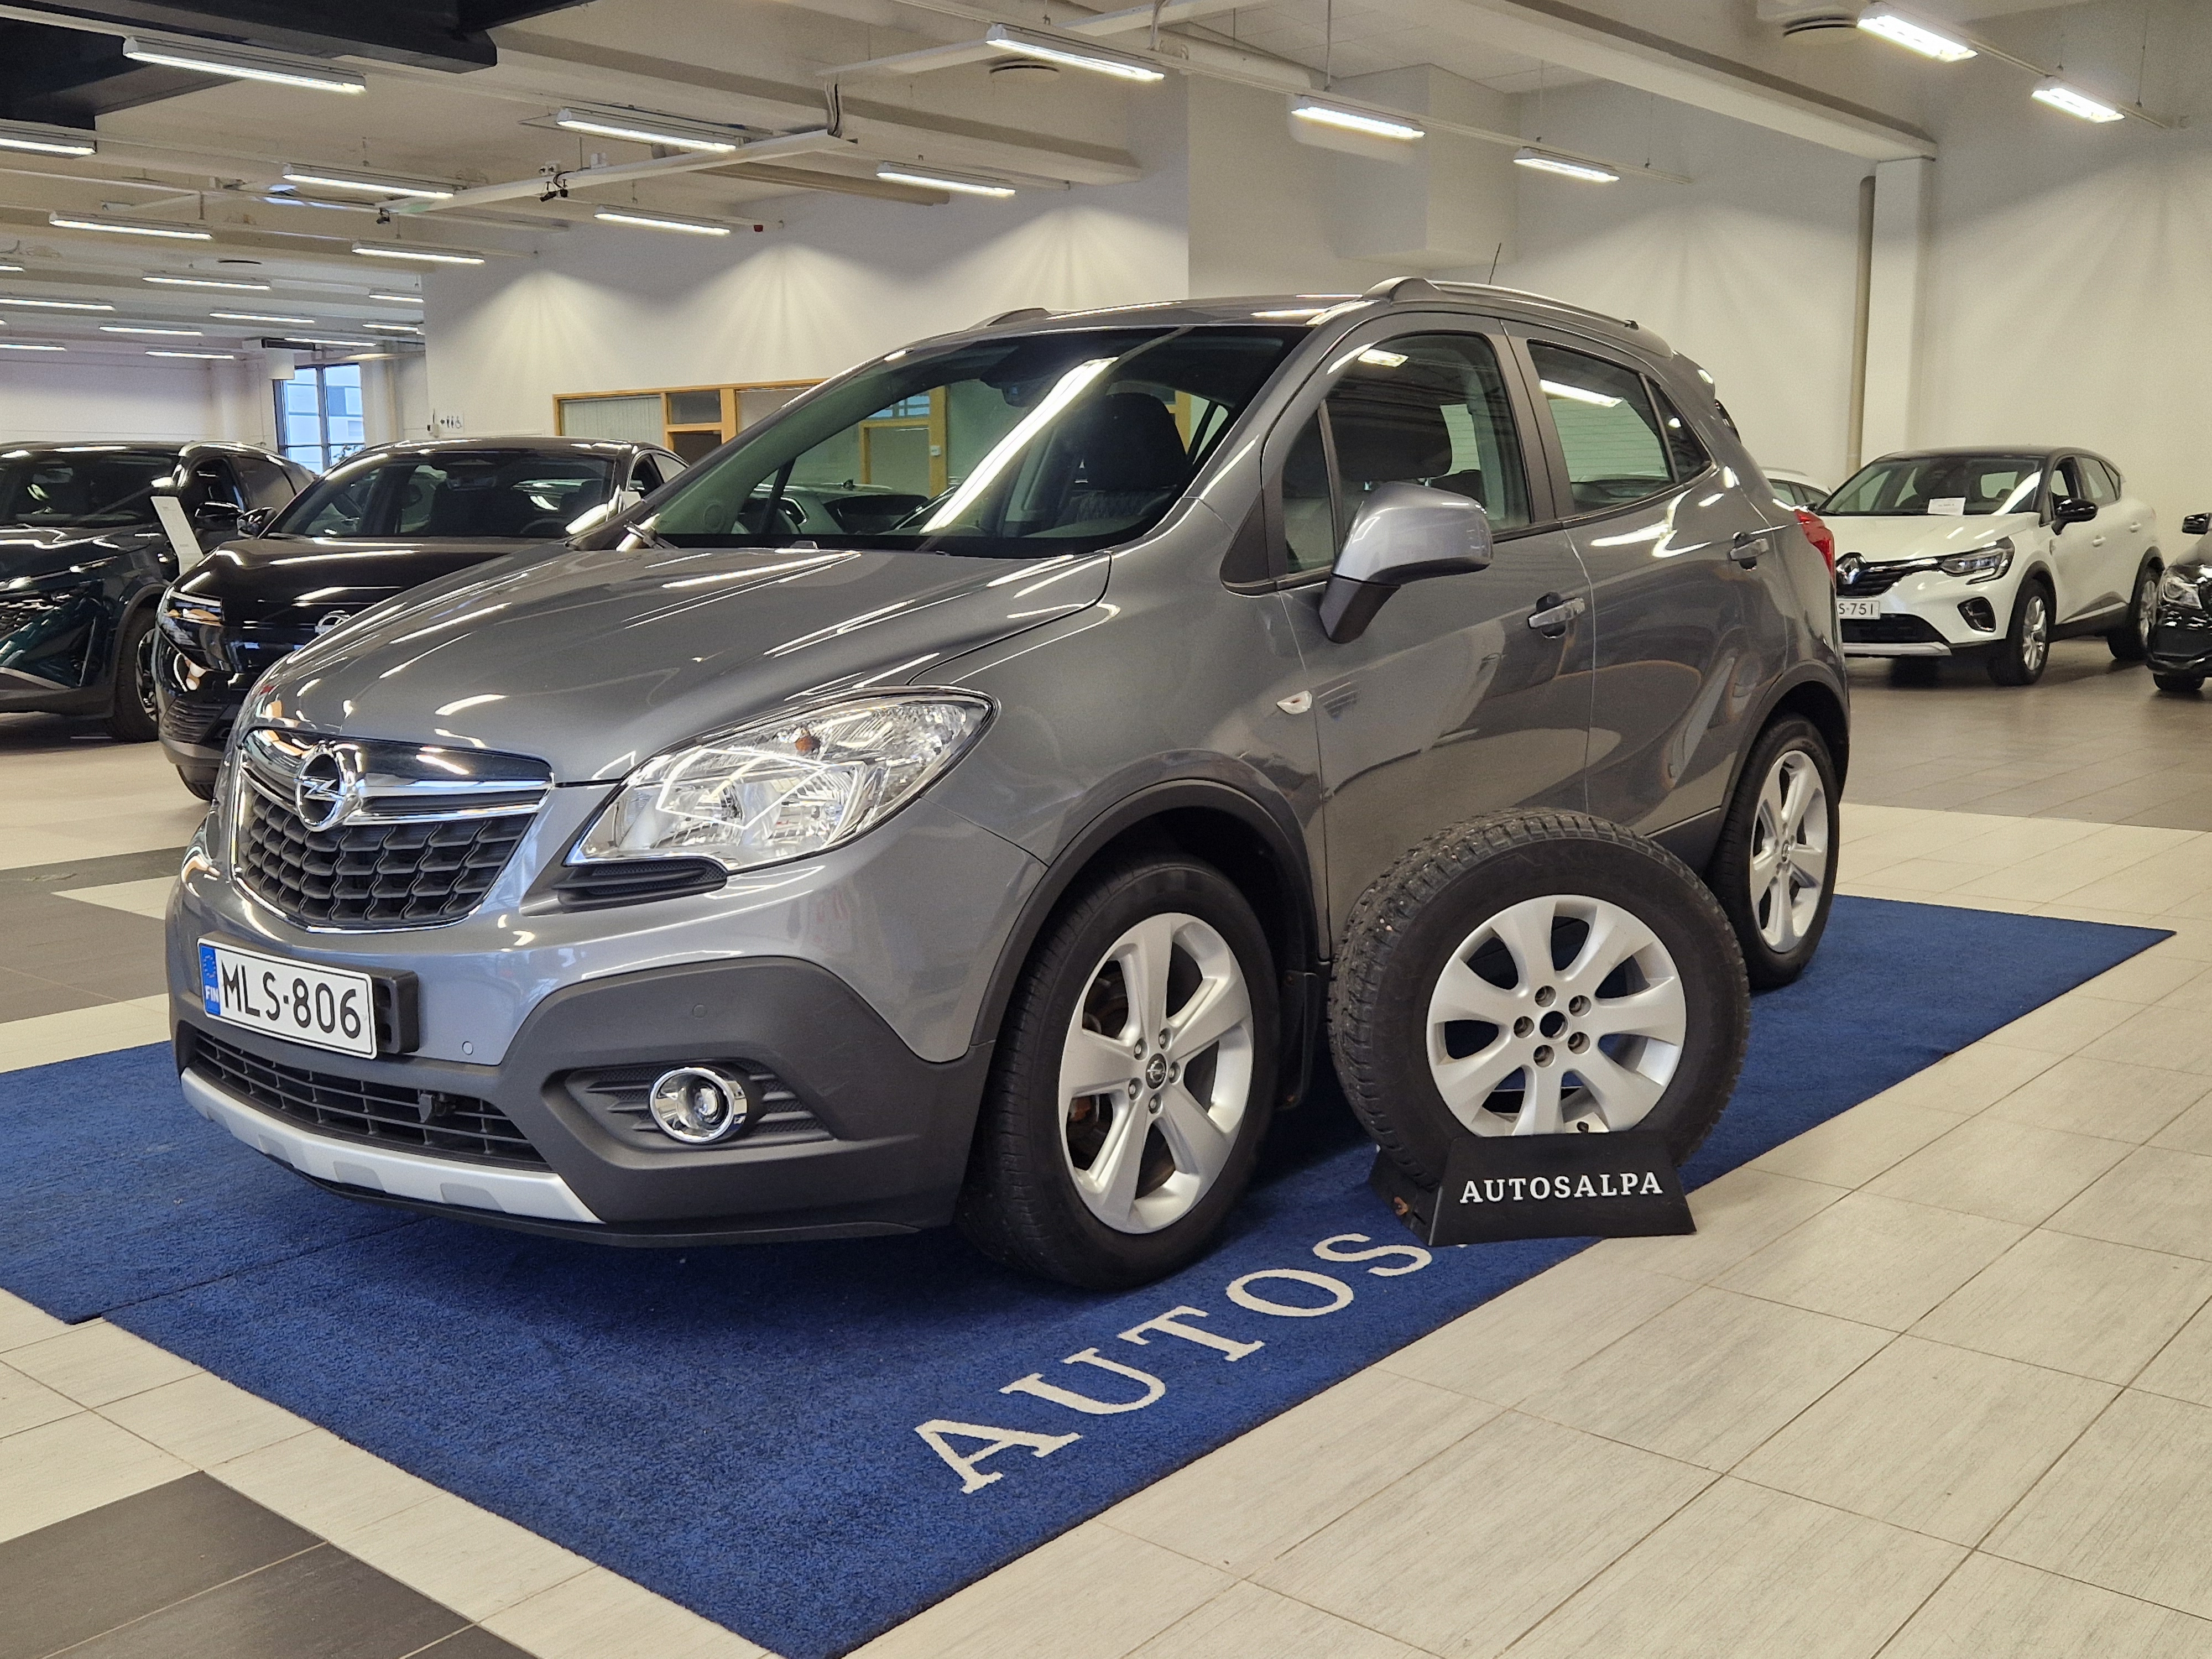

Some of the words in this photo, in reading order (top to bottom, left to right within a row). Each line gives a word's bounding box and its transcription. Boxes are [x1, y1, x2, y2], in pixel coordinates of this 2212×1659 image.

[1838, 603, 1873, 615] S-751
[205, 985, 220, 1003] FIN
[221, 959, 361, 1039] MLS-806
[1459, 1171, 1664, 1204] AUTOSALPA
[914, 1233, 1433, 1494] AUTOS
